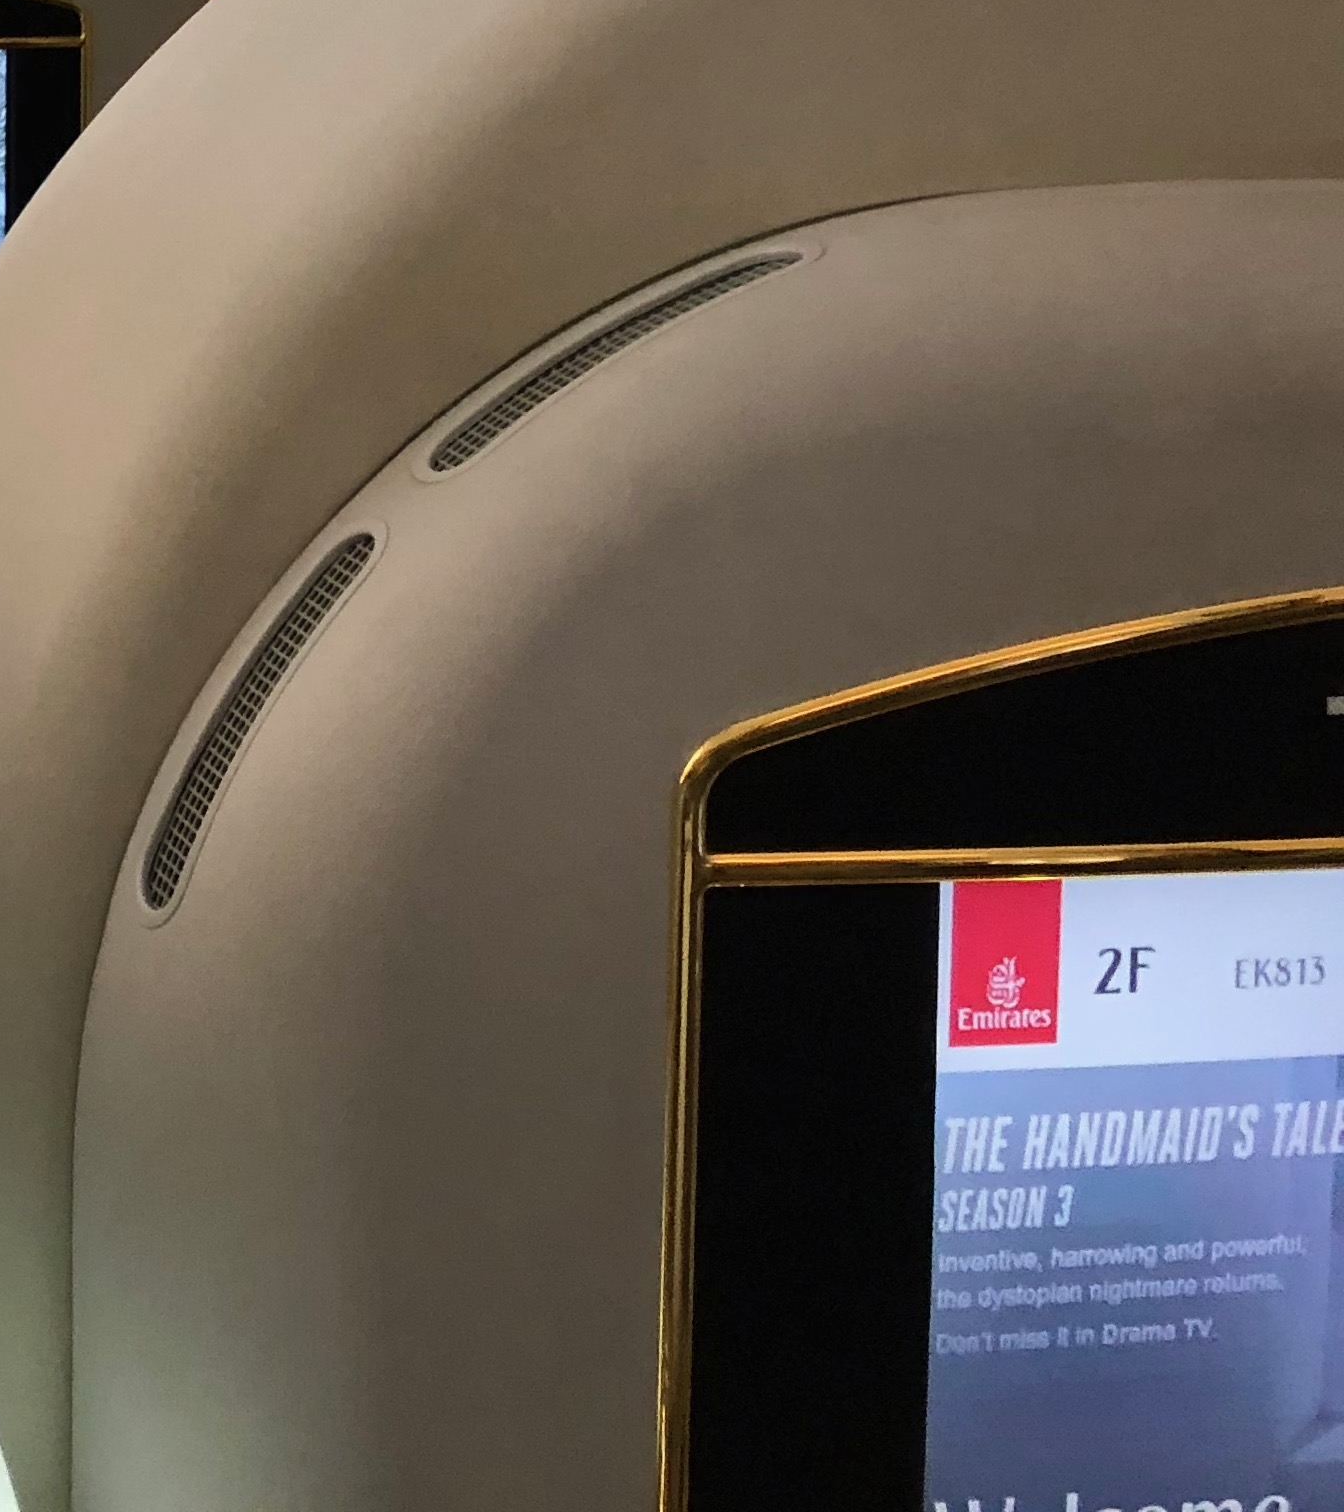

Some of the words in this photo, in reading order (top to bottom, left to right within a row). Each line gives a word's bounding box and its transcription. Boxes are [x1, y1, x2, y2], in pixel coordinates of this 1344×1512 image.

[1093, 945, 1157, 995] 2F
[1233, 955, 1327, 990] EK813
[957, 1007, 1052, 1031] Emirates
[942, 1114, 1014, 1174] THE
[1022, 1102, 1261, 1172] HANDMAID'S
[937, 1186, 1049, 1234] SEASON
[1053, 1184, 1075, 1229] 3
[938, 1249, 1043, 1273] Inventive,
[1050, 1243, 1159, 1270] harrowing
[1163, 1239, 1205, 1262] and
[936, 1287, 972, 1310] the
[977, 1281, 1083, 1312] dystopian
[1088, 1274, 1198, 1306] nightmare
[935, 1330, 995, 1356] Don't
[999, 1329, 1051, 1351] miss
[1056, 1326, 1071, 1348] it
[1076, 1324, 1096, 1346] in
[1101, 1321, 1178, 1346] Drama
